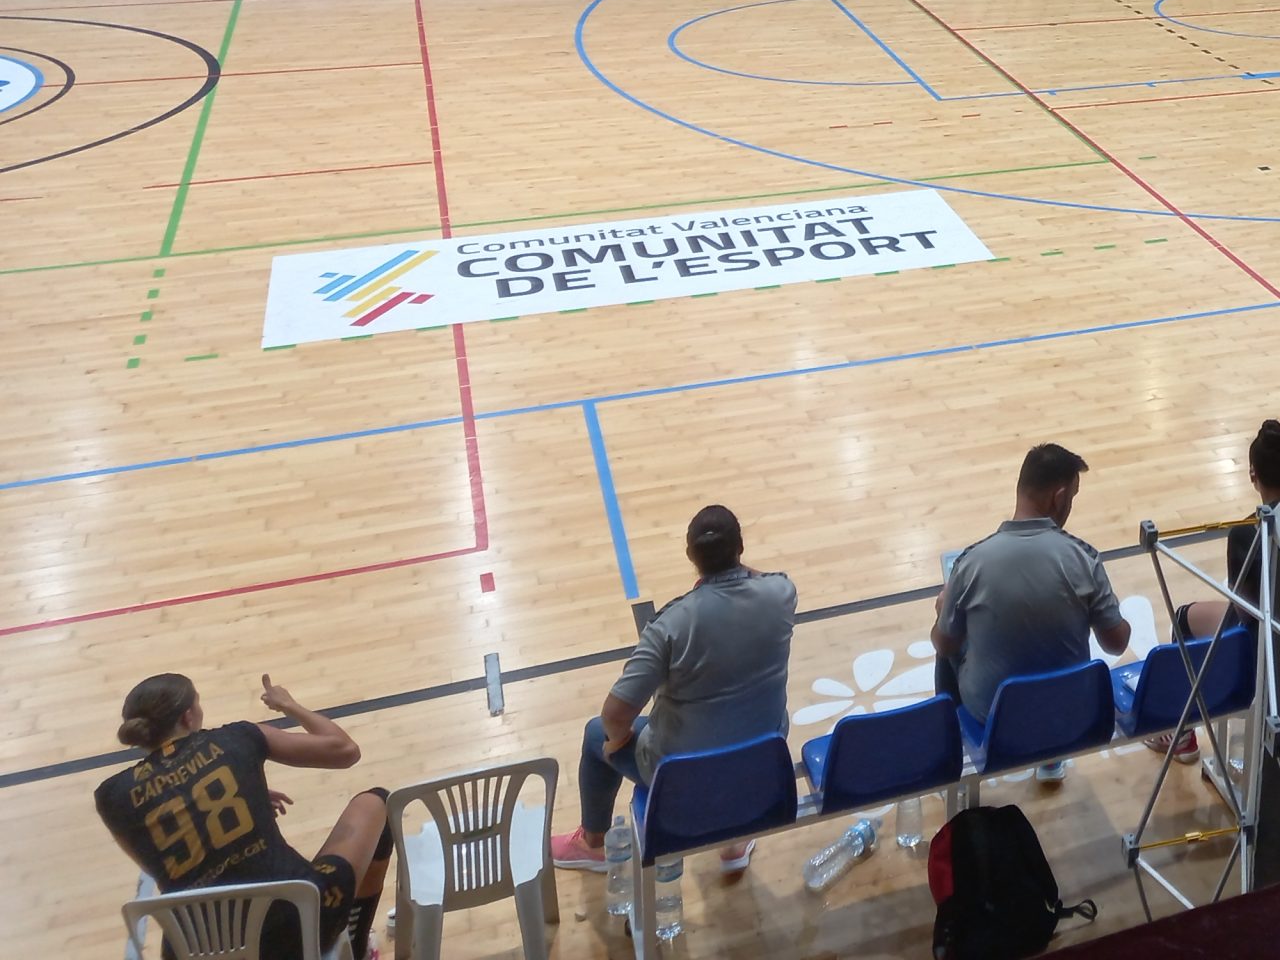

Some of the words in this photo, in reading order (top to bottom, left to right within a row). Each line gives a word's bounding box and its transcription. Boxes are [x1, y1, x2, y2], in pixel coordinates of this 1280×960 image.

[456, 224, 664, 256] Comunitat
[669, 204, 868, 232] Valenciana
[456, 216, 877, 280] COMUNITAT
[496, 266, 595, 300] DE
[622, 229, 940, 286] L'ESPORT
[130, 742, 224, 809] CAPDEVILA
[145, 764, 254, 881] 98
